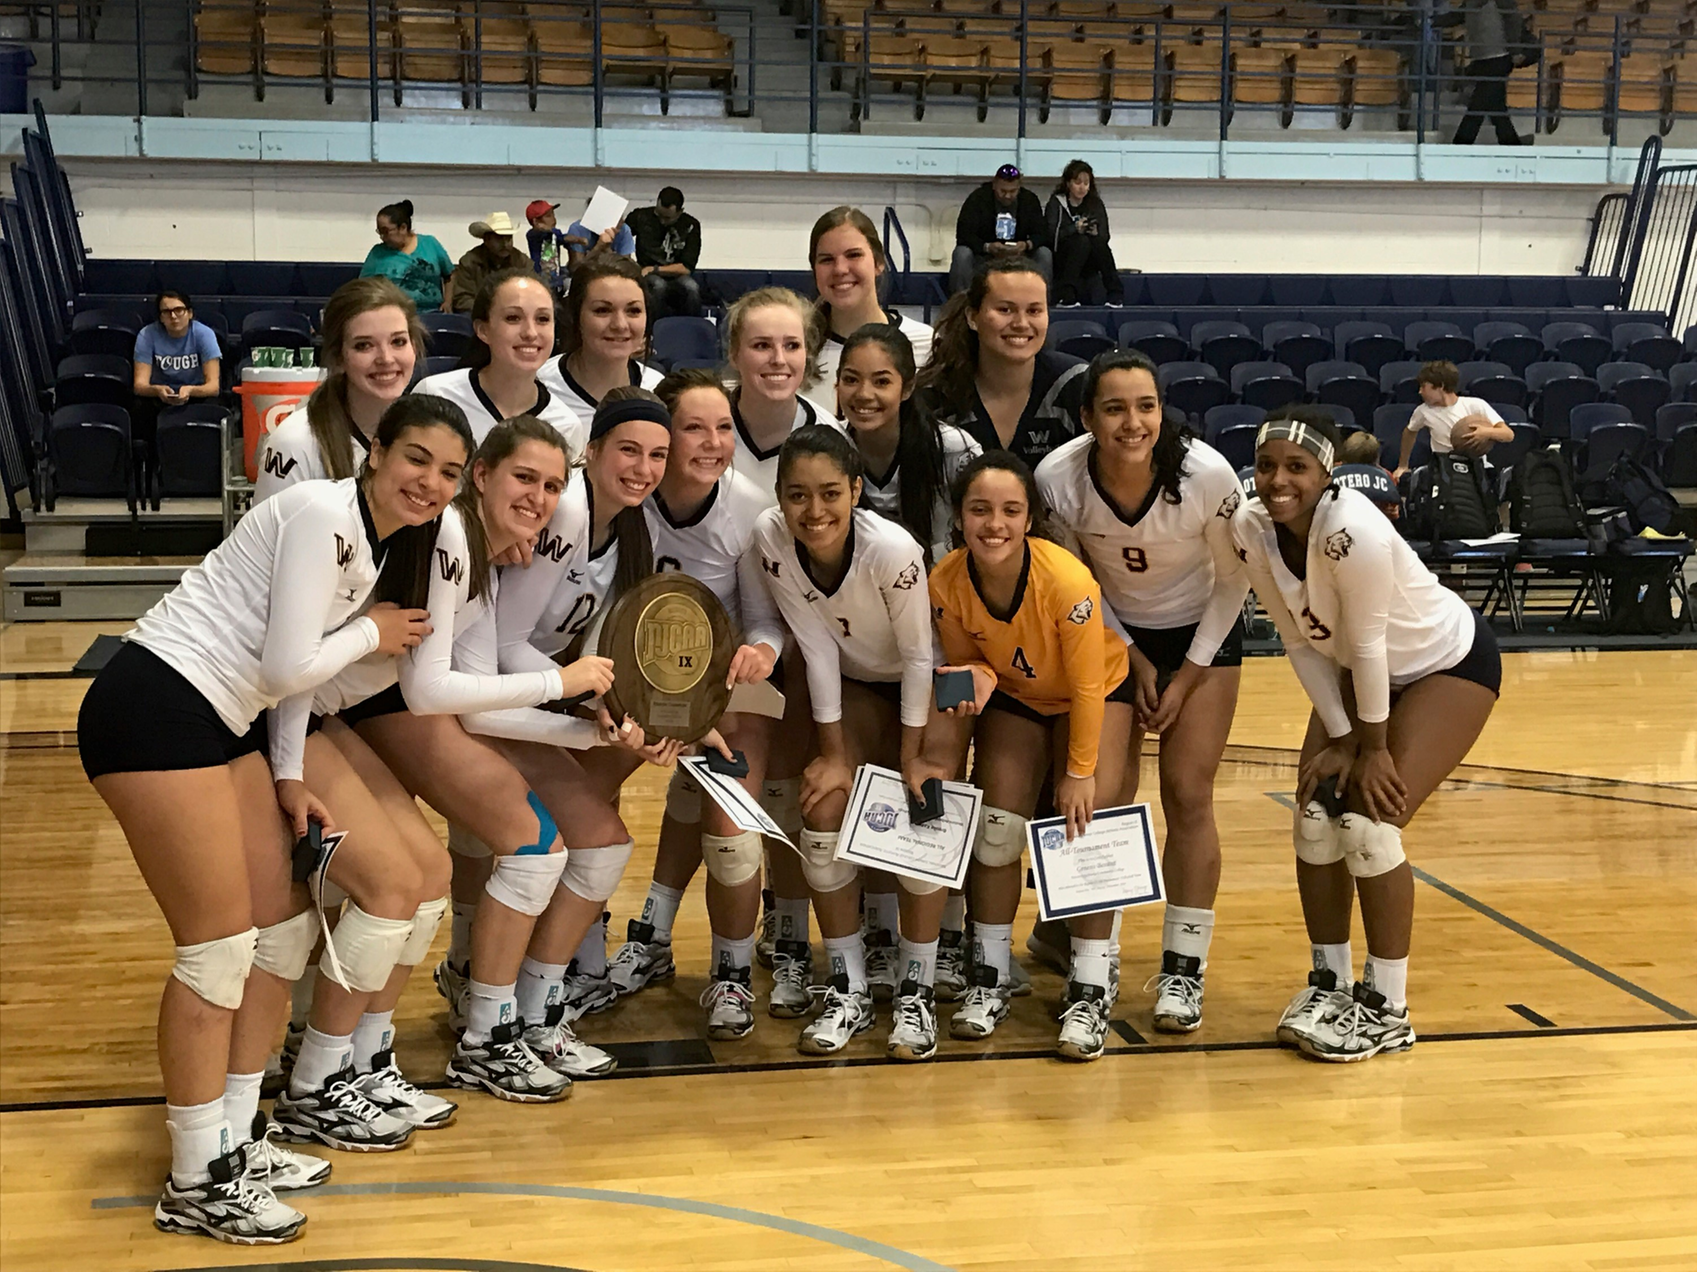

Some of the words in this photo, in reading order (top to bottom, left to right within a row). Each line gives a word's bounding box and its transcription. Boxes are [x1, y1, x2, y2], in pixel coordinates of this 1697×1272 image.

[264, 447, 298, 479] W
[1373, 475, 1388, 492] JC
[536, 527, 573, 563] W
[1122, 547, 1149, 573] 9
[555, 592, 596, 635] 12
[678, 656, 693, 667] IX
[1011, 646, 1037, 678] 4
